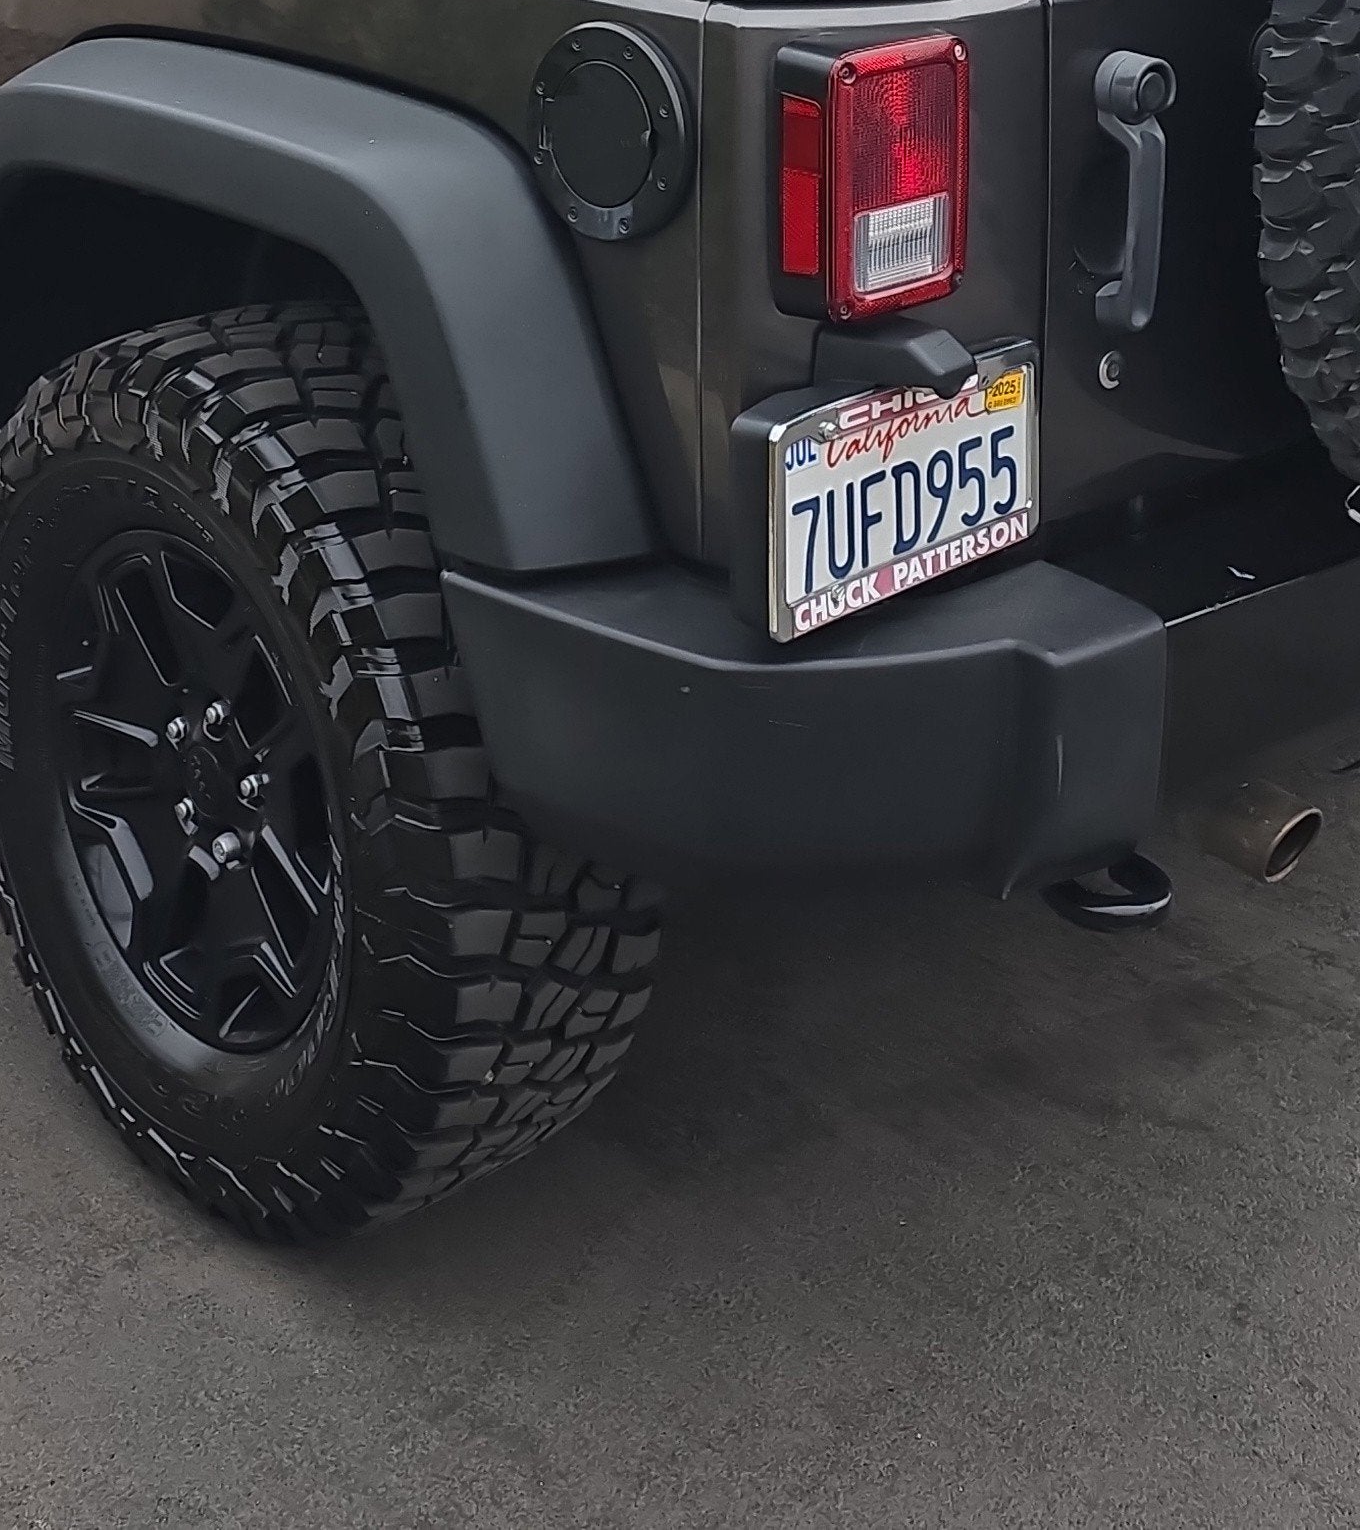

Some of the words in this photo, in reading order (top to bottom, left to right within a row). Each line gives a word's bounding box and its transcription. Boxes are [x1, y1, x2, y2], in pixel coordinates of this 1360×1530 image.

[992, 379, 1016, 398] 2025
[785, 437, 817, 469] JUL
[825, 394, 990, 468] California
[790, 425, 1018, 595] 7UFD955
[794, 571, 882, 633] CHUCK
[892, 510, 1029, 592] PATTERSON
